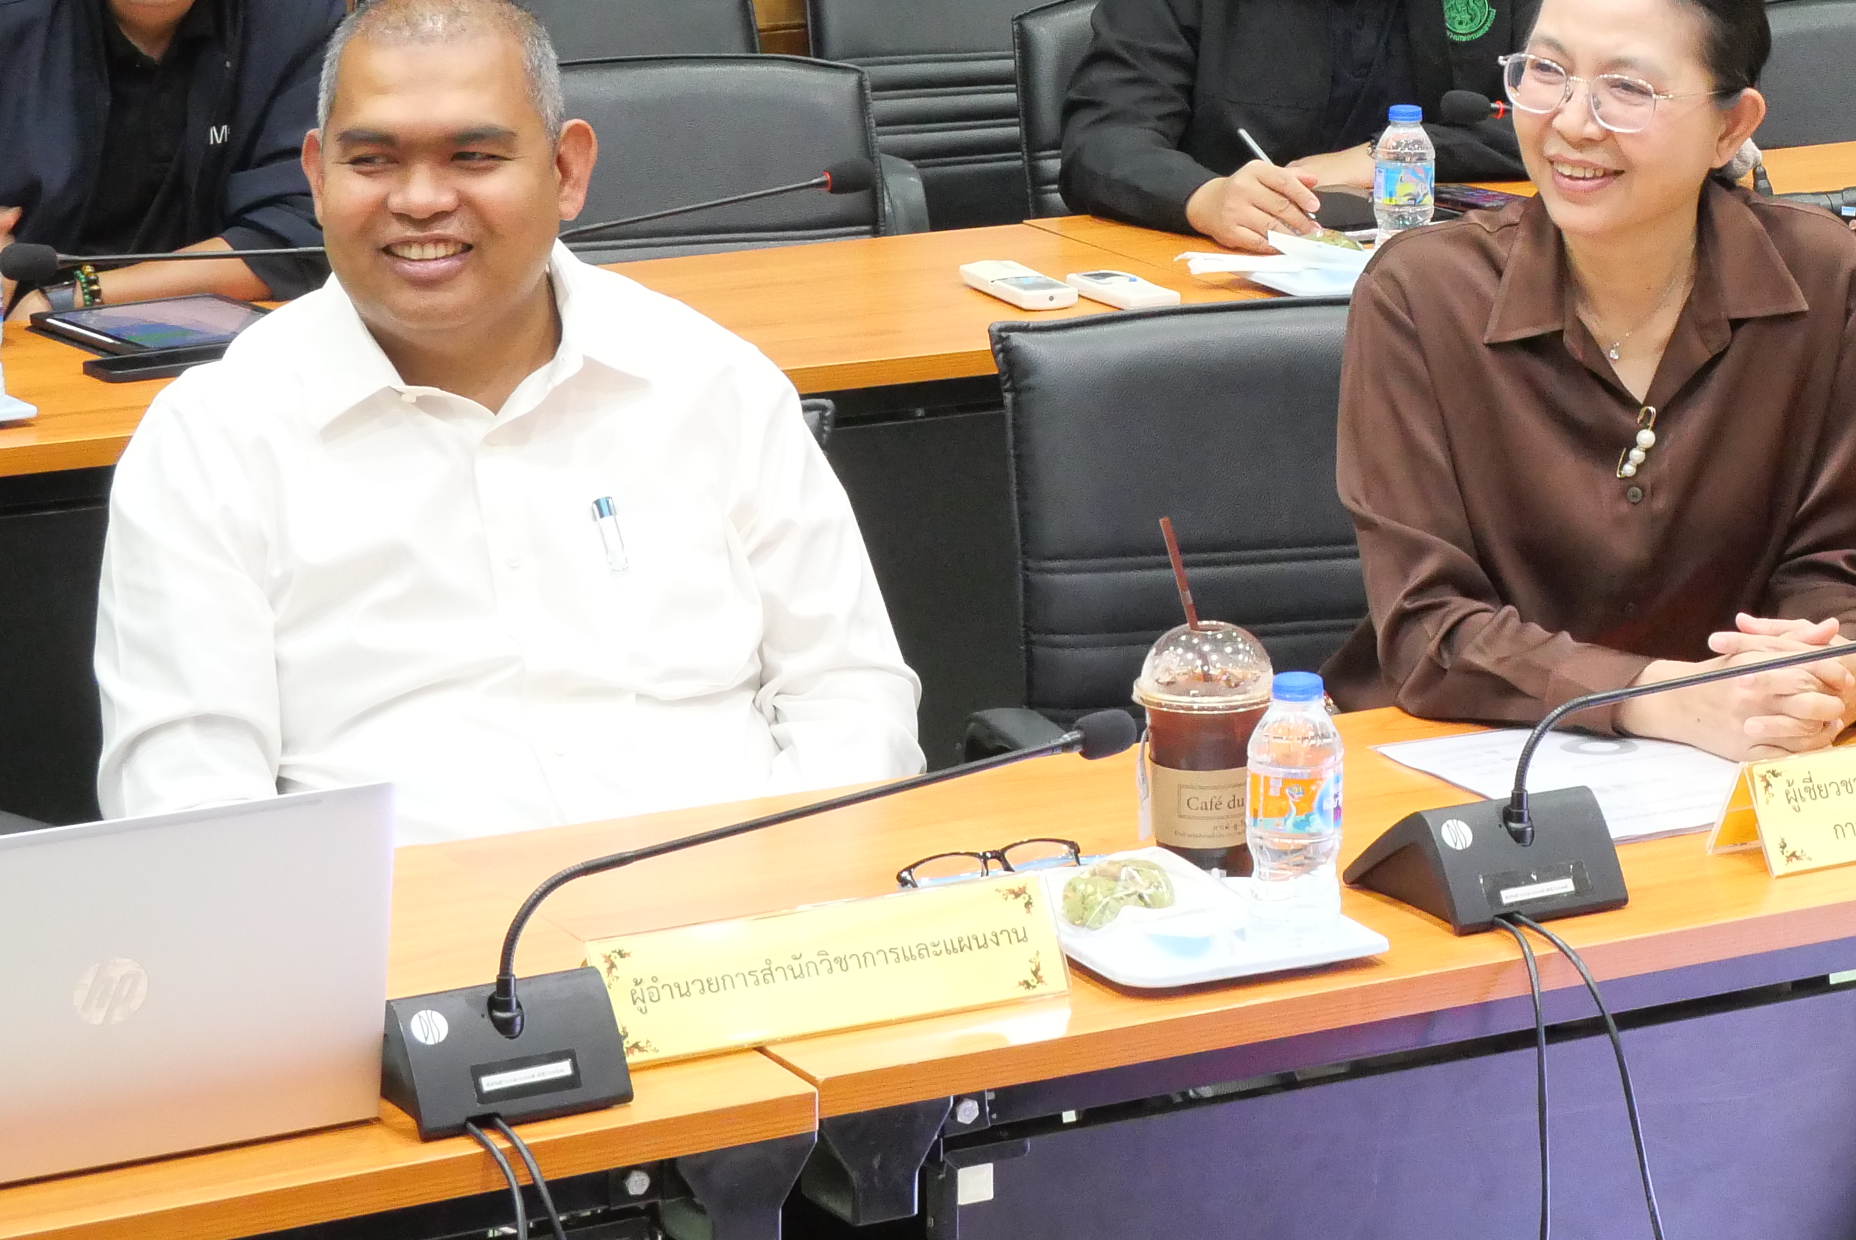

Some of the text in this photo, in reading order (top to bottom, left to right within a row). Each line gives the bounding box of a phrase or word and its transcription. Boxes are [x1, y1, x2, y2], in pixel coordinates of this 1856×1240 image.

[1186, 794, 1245, 811] Café du
[77, 958, 145, 1027] hp
[629, 921, 1029, 1016] ผู้อำนวยการสำนักวิชาการและแผนงาน
